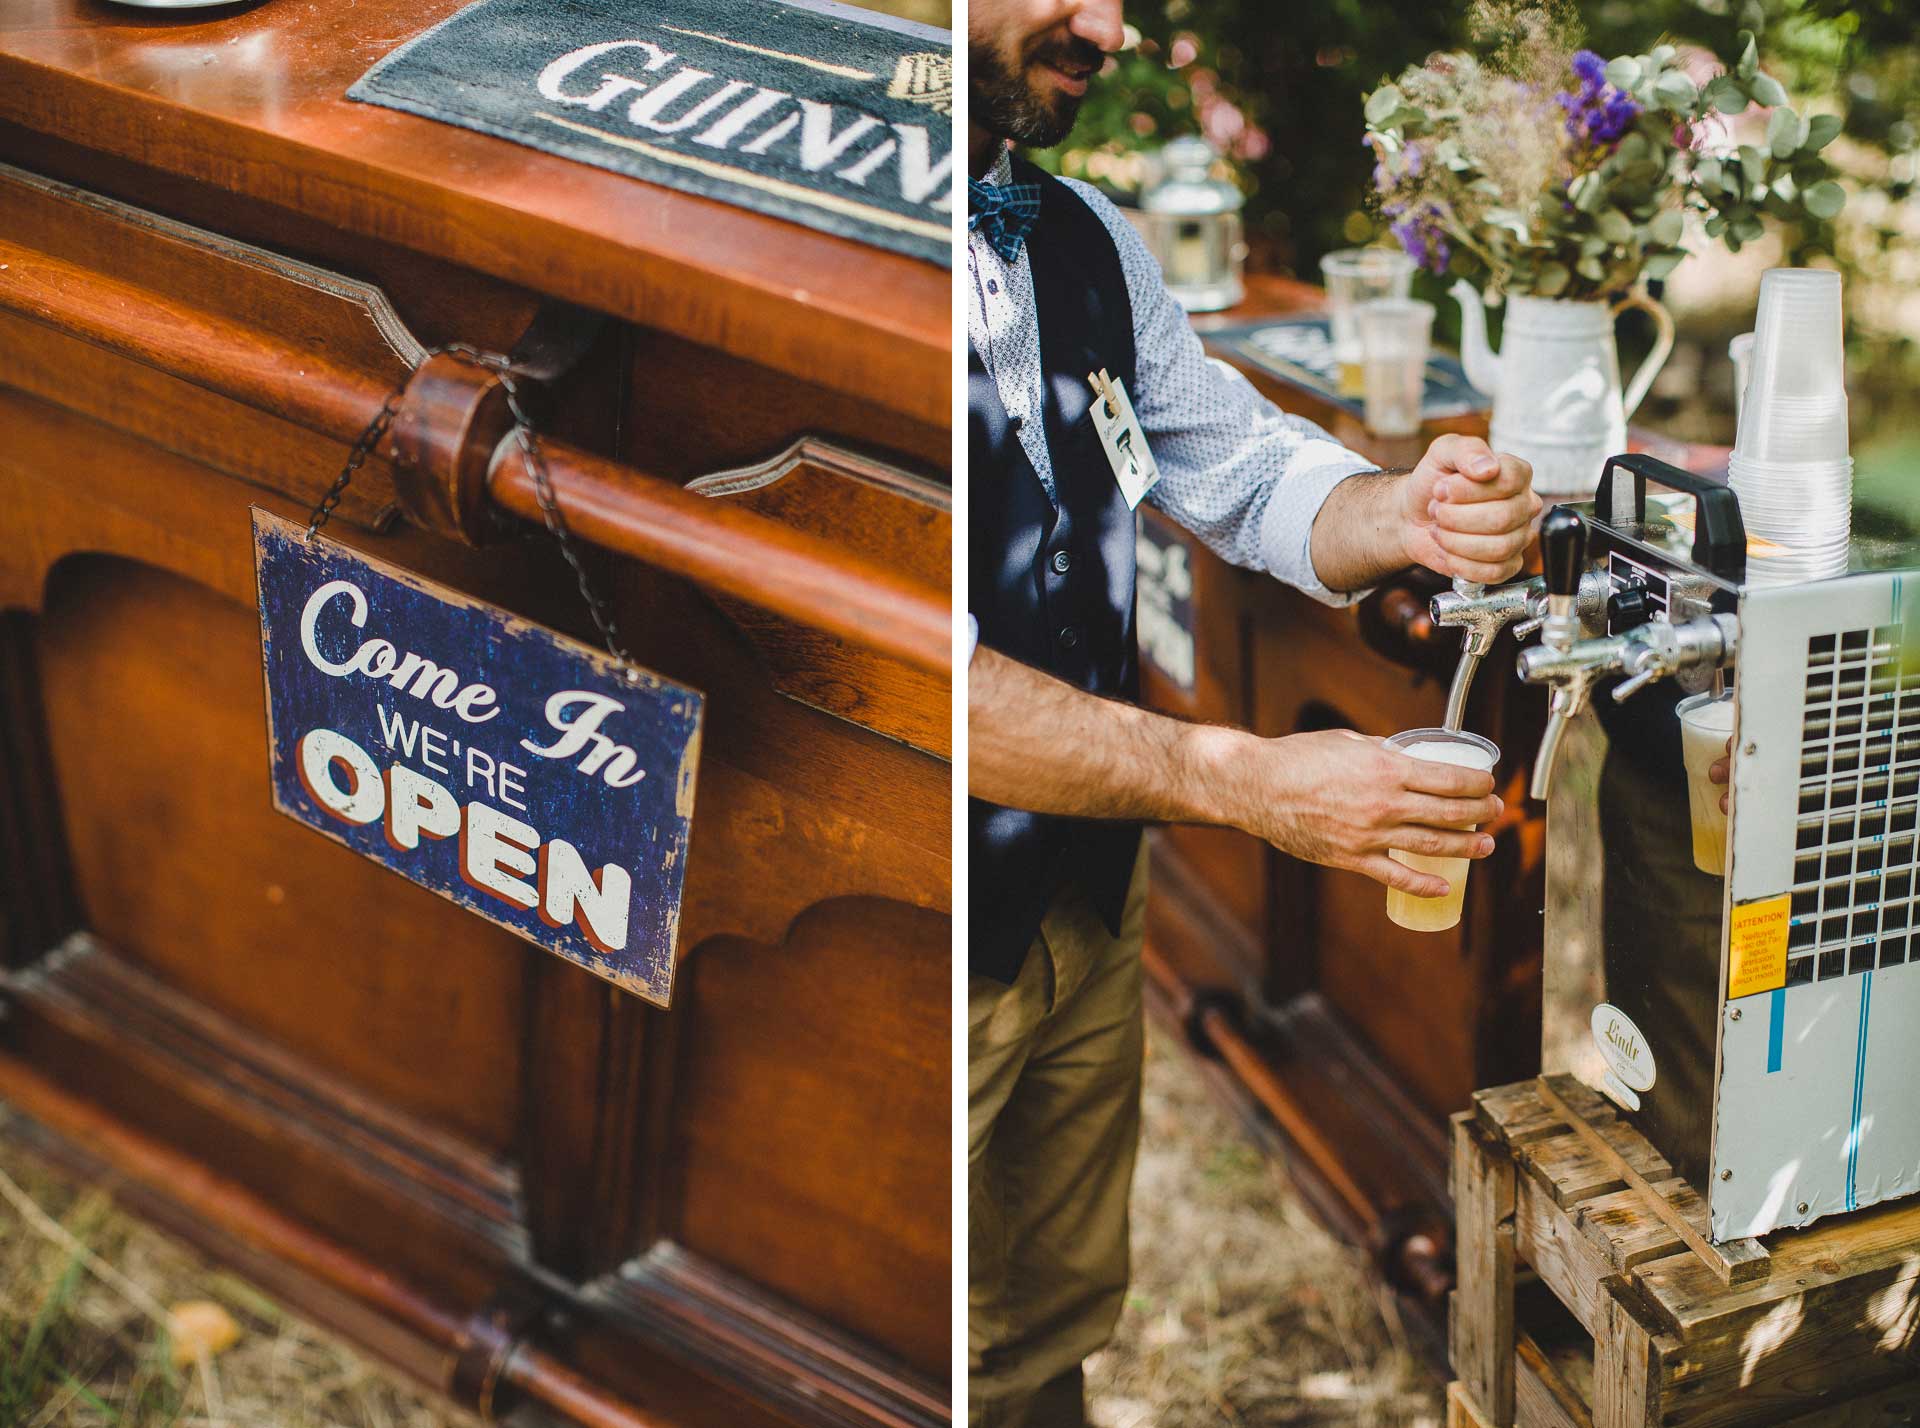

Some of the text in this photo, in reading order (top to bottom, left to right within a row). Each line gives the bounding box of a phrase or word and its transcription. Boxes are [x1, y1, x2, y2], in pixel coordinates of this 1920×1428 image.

[537, 40, 952, 213] GUINN
[301, 580, 645, 787] Come In
[376, 704, 527, 811] WE'RE
[296, 728, 631, 952] OPEN
[1605, 1019, 1639, 1061] Lindr
